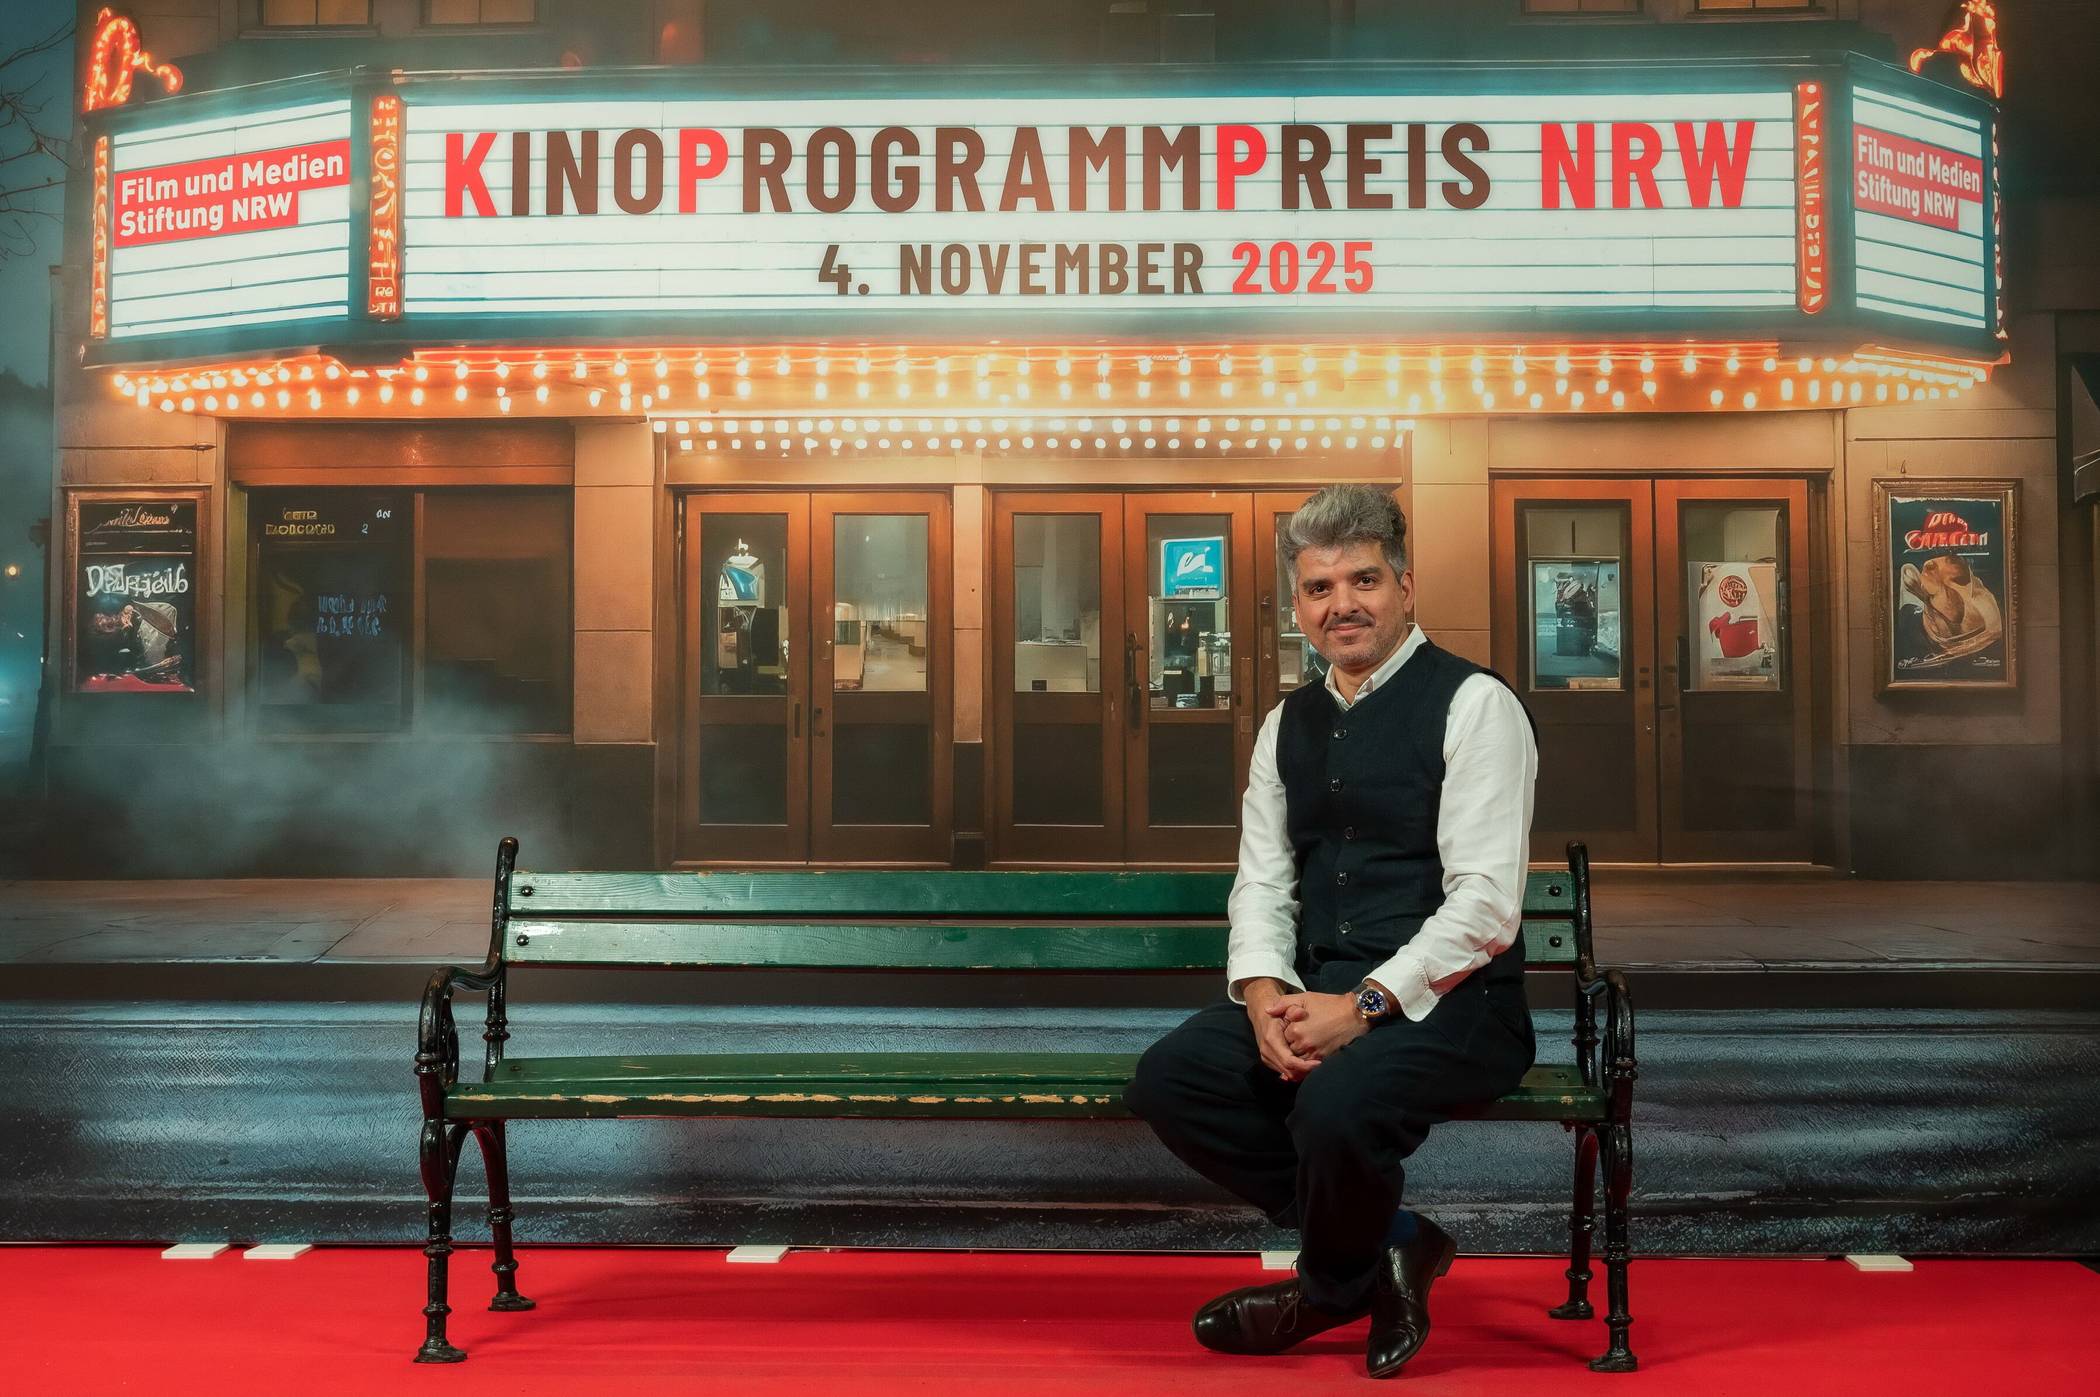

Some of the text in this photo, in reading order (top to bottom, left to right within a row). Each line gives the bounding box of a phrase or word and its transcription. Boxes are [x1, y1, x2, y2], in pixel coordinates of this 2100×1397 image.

[121, 154, 344, 205] Film und Medien
[445, 123, 1492, 217] KINOPROGRAMMPREIS
[1541, 121, 1756, 209] NRW
[1858, 134, 1980, 193] Film und Medien
[119, 192, 292, 237] Stiftung NRW
[1858, 170, 1956, 219] Stiftung NRW
[817, 241, 1374, 295] 4. NOVEMBER 2025
